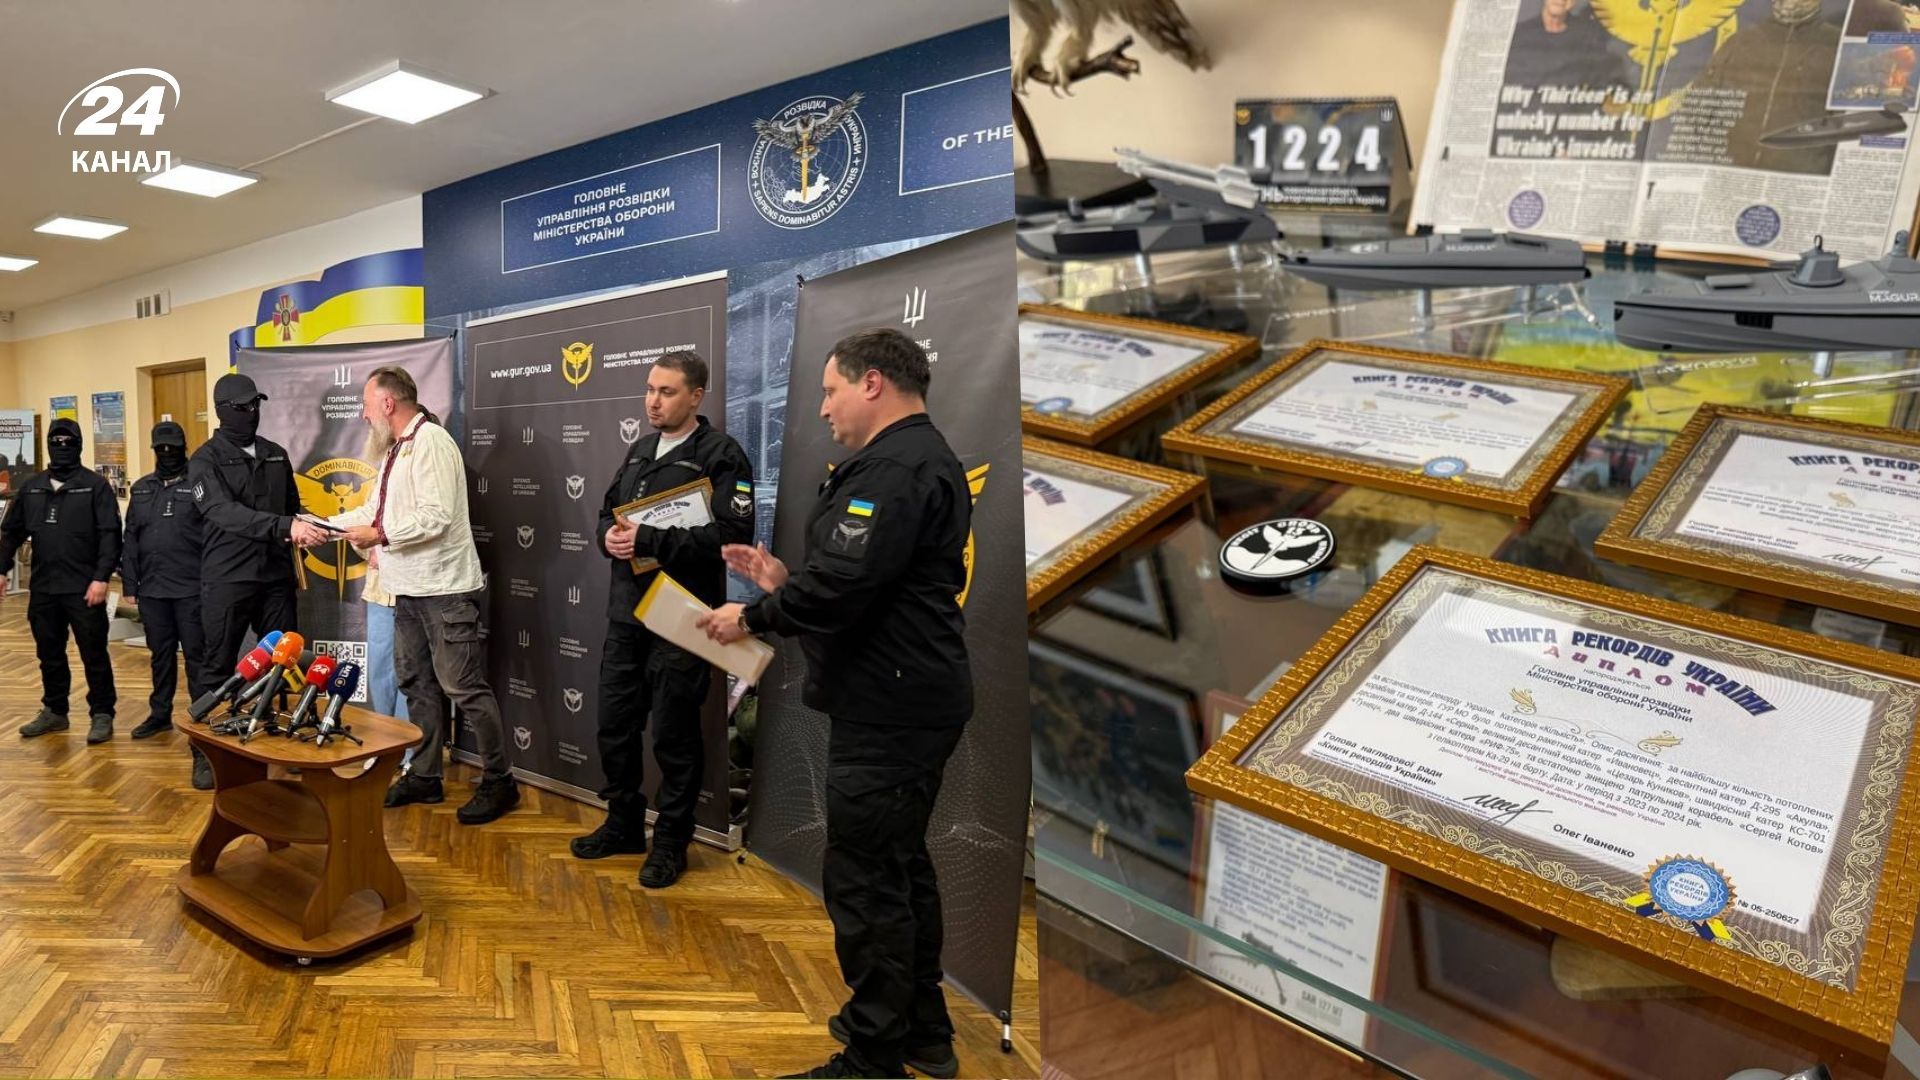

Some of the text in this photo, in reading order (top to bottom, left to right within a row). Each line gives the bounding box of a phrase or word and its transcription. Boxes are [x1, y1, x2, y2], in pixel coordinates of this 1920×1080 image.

[1501, 85, 1533, 108] Why
[1613, 85, 1628, 104] is
[784, 100, 827, 119] РОЗВІДКА
[844, 114, 862, 155] УКРАЇНИ
[942, 124, 1013, 150] OF THE
[1496, 109, 1646, 135] unlucky number for
[1567, 136, 1636, 159] invaders
[536, 187, 671, 227] УПРАВЛІННЯ РОЗВІДКИ
[574, 183, 627, 205] ГОЛОВНЕ
[754, 167, 859, 225] SAPIENS DOMINABITUR ASTRIS
[533, 201, 675, 241] МІНІСТЕРСТВА ОБОРОНИ
[575, 227, 625, 246] УКРАЇНИ
[1869, 292, 1920, 303] MAGUR
[490, 362, 552, 379] www.gur.gov.ua
[1862, 456, 1920, 472] РЕКОР
[1485, 627, 1778, 716] КНИГА РЕКОРДІВ УКРАЇНИ
[1531, 664, 1692, 715] Головне управління розвідки
[1525, 670, 1693, 723] Міністерства оборони України
[1316, 739, 1350, 755] «Книги
[1348, 751, 1393, 771] рекордів
[1392, 766, 1438, 787] України»
[1323, 732, 1358, 747] Голова
[1359, 744, 1416, 769] наглядової
[1416, 763, 1444, 778] ради
[1417, 708, 1443, 721] Д-144
[1481, 727, 1516, 743] великий
[1514, 738, 1561, 758] десантний
[1559, 752, 1604, 772] корабель
[1605, 767, 1646, 786] «Цезарь
[1693, 794, 1752, 819] швидкісний
[1754, 813, 1785, 830] катер
[1788, 824, 1827, 842] КС-701
[1436, 703, 1455, 713] ГУР
[1453, 708, 1470, 717] МО
[1469, 713, 1492, 725] було
[1492, 720, 1537, 738] потоплено
[1535, 734, 1577, 752] ракетний
[1575, 746, 1603, 760] катер
[1665, 774, 1718, 797] десантний
[1718, 790, 1748, 806] катер
[1749, 799, 1782, 817] Д-295
[1785, 810, 1832, 832] «Акула»,
[1498, 712, 1538, 729] Категорія
[1590, 740, 1615, 752] Опис
[1666, 763, 1680, 772] за
[1679, 767, 1730, 789] найбільшу
[1731, 783, 1774, 801] кількість
[1774, 796, 1834, 820] потоплених
[1446, 728, 1477, 743] катера
[1524, 753, 1537, 761] та
[1536, 756, 1582, 776] остаточно
[1583, 771, 1626, 791] знищено
[1627, 785, 1684, 810] патрульний
[1688, 805, 1735, 827] корабель
[1737, 820, 1782, 842] «Сергей
[1786, 836, 1824, 854] Котов»
[1484, 751, 1510, 764] Ка-29
[1509, 759, 1522, 768] на
[1519, 763, 1550, 779] борту.
[1548, 772, 1576, 787] Дата:
[1575, 781, 1584, 790] у
[1582, 783, 1615, 800] період
[1614, 793, 1622, 801] з
[1622, 796, 1647, 809] 2023
[1646, 803, 1661, 814] по
[1661, 808, 1686, 822] 2024
[1685, 816, 1704, 830] рік.
[1552, 823, 1636, 858] Олег Іваненко
[1750, 903, 1799, 925] 05-250627
